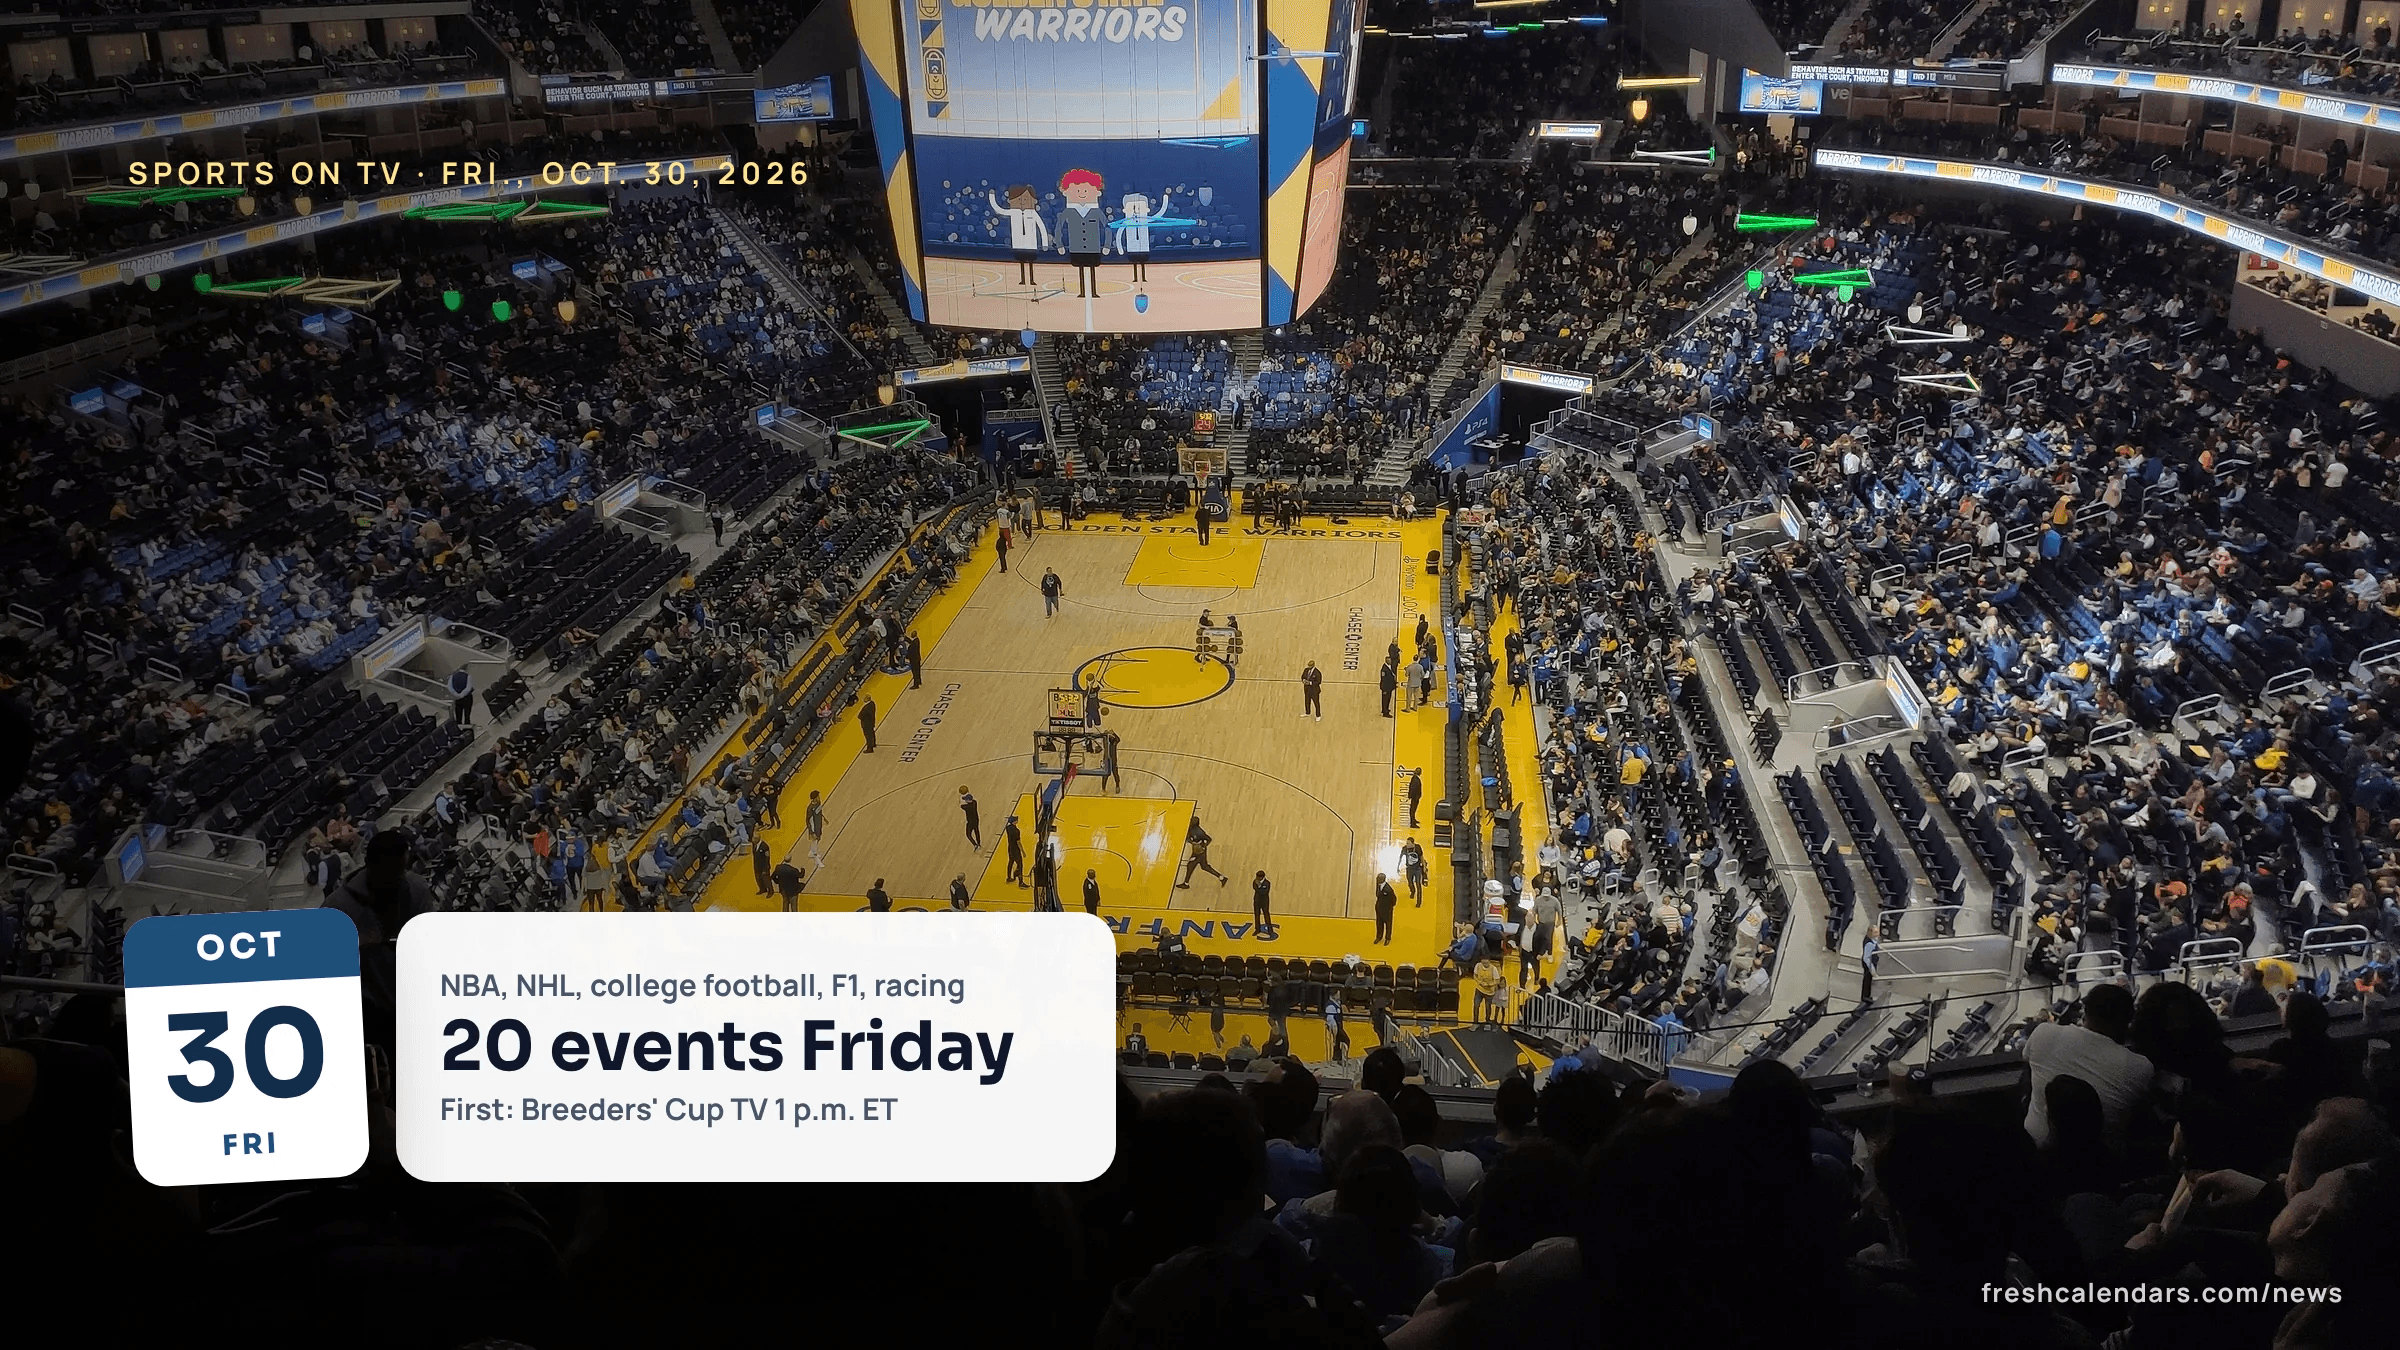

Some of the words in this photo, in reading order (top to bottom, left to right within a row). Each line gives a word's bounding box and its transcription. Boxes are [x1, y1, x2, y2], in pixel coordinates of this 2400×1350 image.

[973, 7, 1188, 44] WARRIORS
[1791, 65, 1827, 74] BEHAVIOR
[1828, 67, 1845, 75] SUCH
[1880, 69, 1889, 77] TO
[1791, 72, 1814, 80] ENTER
[1829, 73, 1852, 83] COURT,
[1853, 74, 1888, 83] THROWING
[545, 86, 582, 96] BEHAVIOR
[583, 85, 602, 94] SUCH
[603, 84, 613, 93] AS
[613, 83, 638, 92] TRYING
[639, 82, 649, 90] TO
[546, 94, 566, 103] ENTER
[567, 93, 584, 101] THE
[586, 91, 611, 101] COURT,
[612, 89, 650, 99] THROWING
[2189, 78, 2236, 97] WARRIORS
[2303, 95, 2346, 117] WARRIORS
[57, 126, 115, 148] WARRIORS
[1973, 166, 2021, 185] WARRIORS
[2117, 191, 2161, 212] WARRIORS
[277, 215, 321, 236] WARRIORS
[2227, 226, 2265, 250] WARRIORS
[1541, 373, 1585, 389] WARRIORS
[1197, 420, 1210, 430] 24
[1472, 417, 1488, 431] PS4
[1149, 525, 1229, 536] STAE
[1242, 527, 1402, 540] WARRIORS
[1347, 606, 1363, 633] CHASE
[1343, 642, 1360, 671] CENTER
[929, 683, 961, 716] CHASE
[898, 727, 933, 763] CENTER
